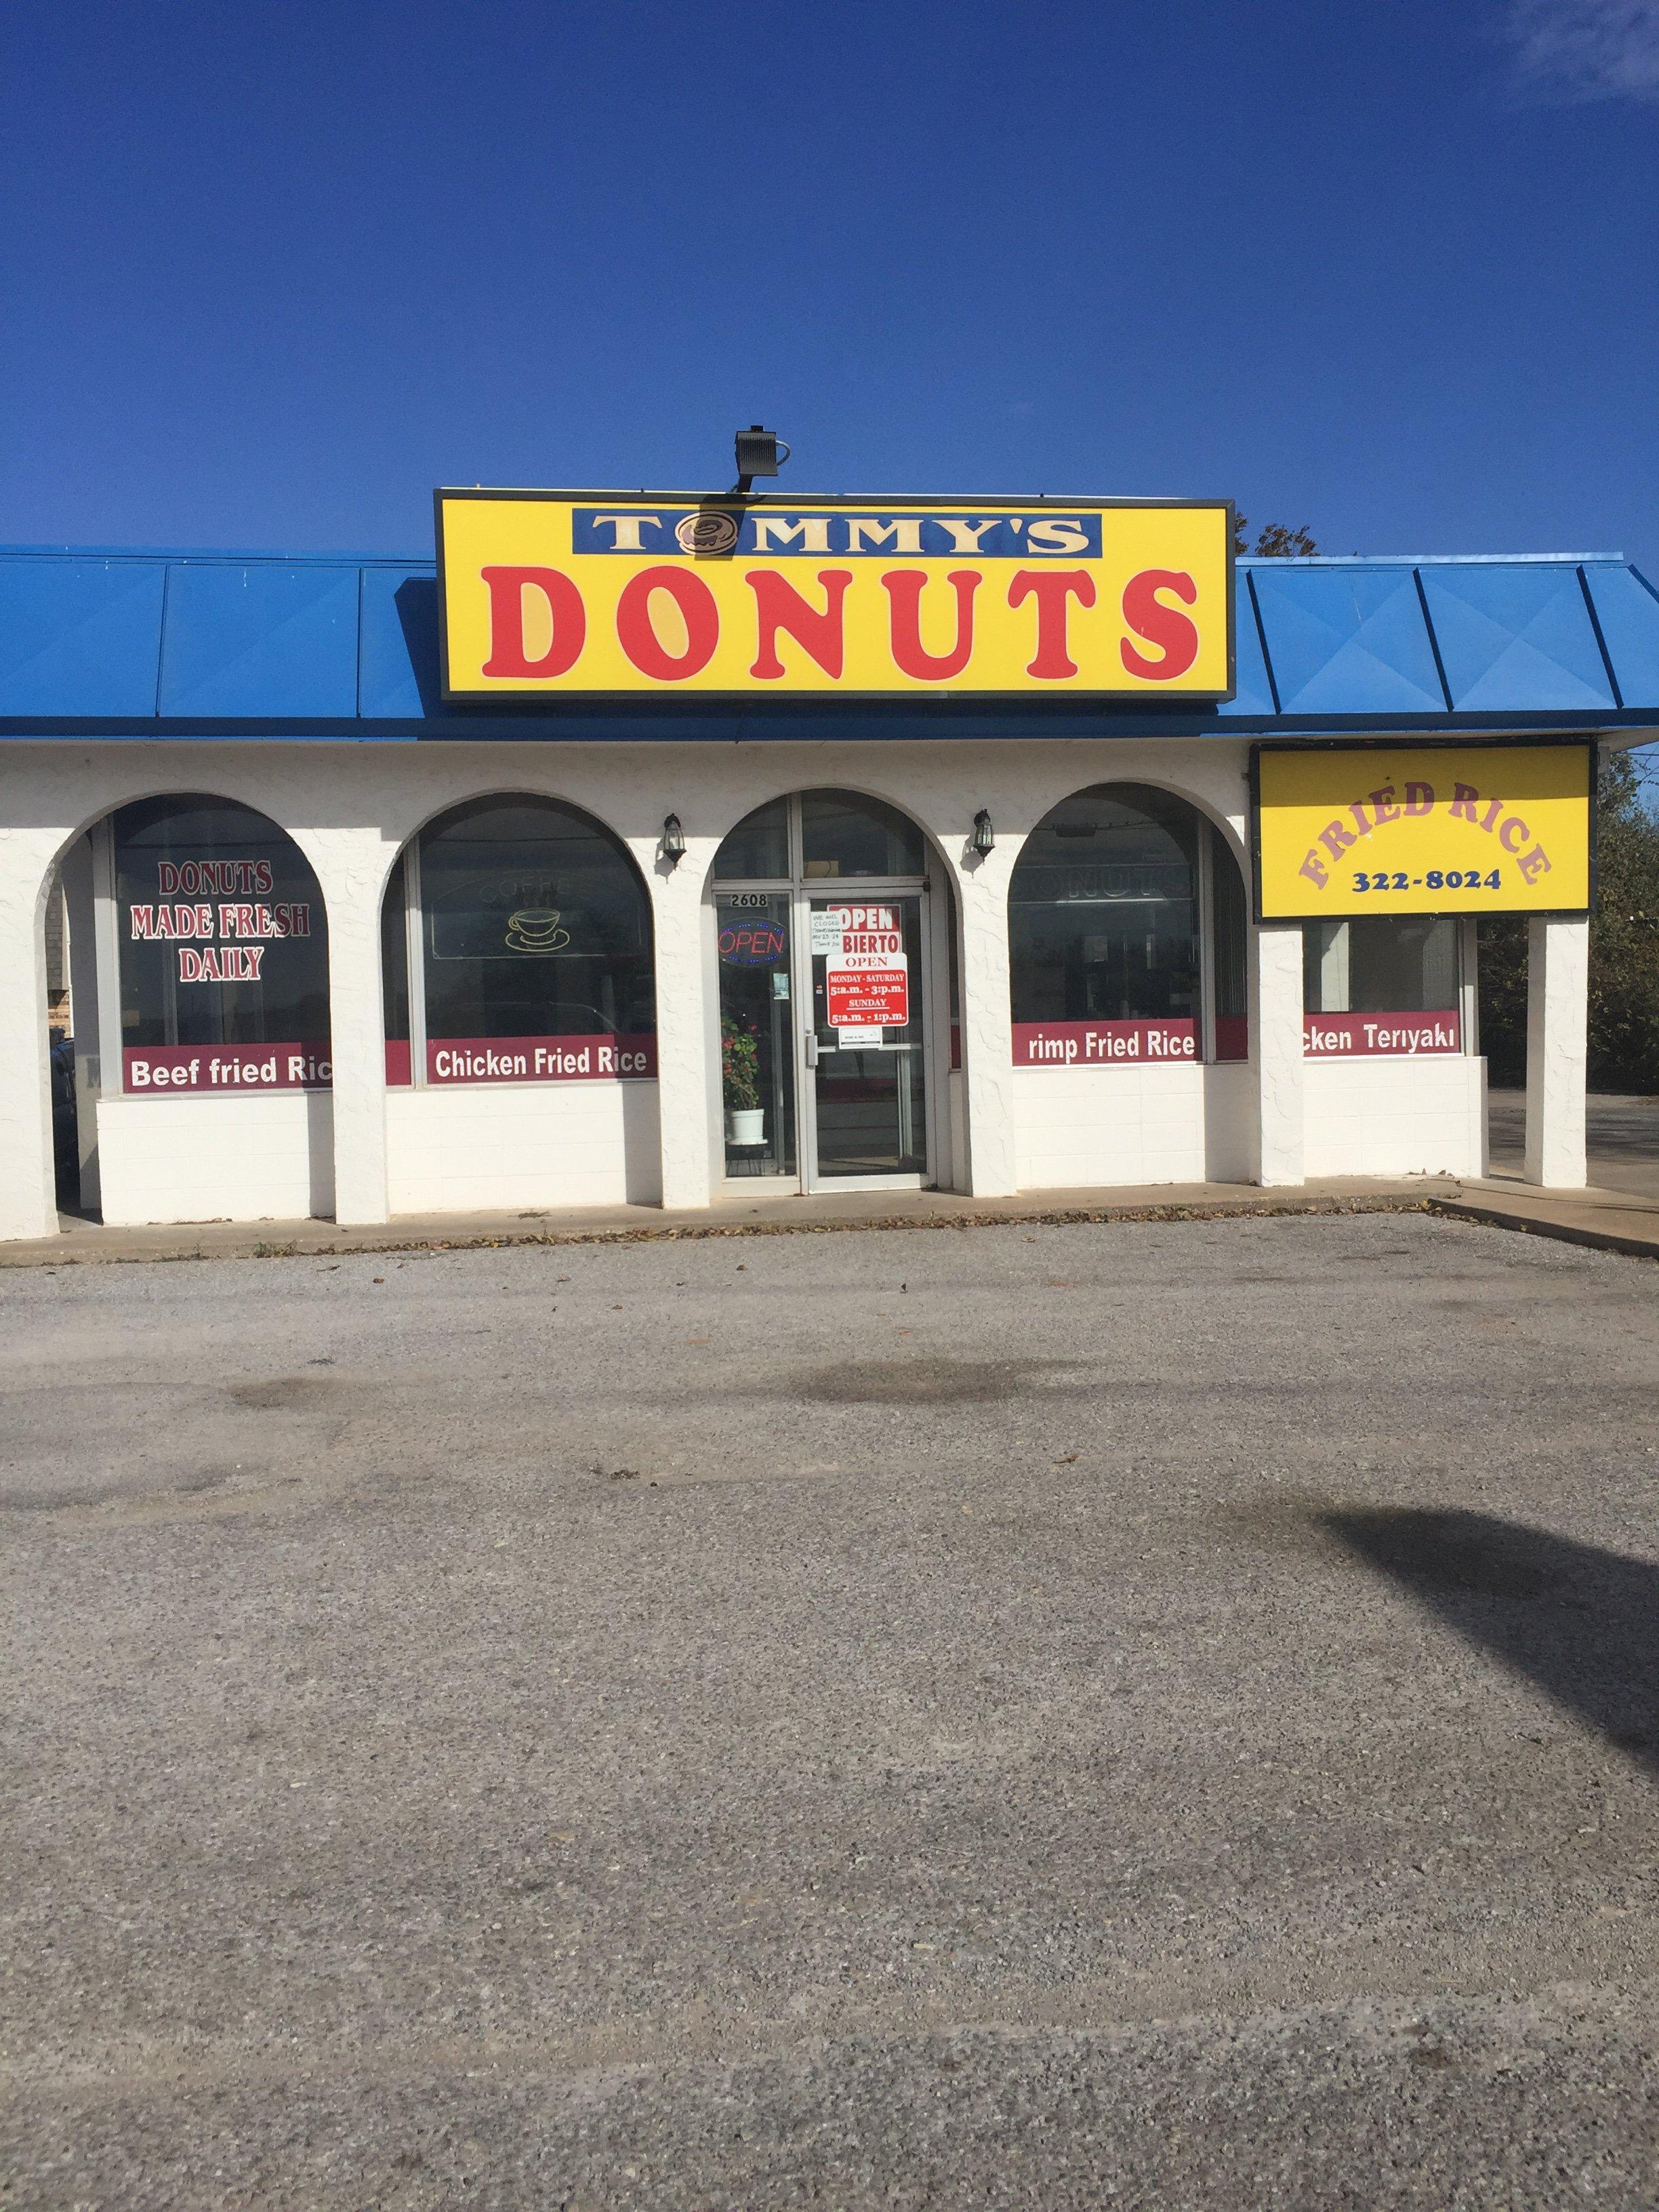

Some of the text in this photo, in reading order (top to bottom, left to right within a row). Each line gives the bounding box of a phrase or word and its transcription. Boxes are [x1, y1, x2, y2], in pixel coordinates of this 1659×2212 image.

[592, 510, 1091, 556] TOMMY'S
[480, 565, 1200, 681] DONUTS
[1298, 781, 1552, 890] FRIED RICE
[158, 860, 273, 895] DONUTS
[1351, 869, 1502, 892] 322-8024
[731, 894, 767, 906] 2608
[130, 903, 310, 939] MADE FRESH
[838, 907, 893, 930] OPEN
[718, 931, 785, 954] OPEN
[178, 946, 264, 982] DAILY
[845, 957, 888, 967] OPEN
[830, 975, 862, 983] MONDAY
[866, 974, 905, 982] SATURDAY
[831, 986, 863, 996] 5:a.m.
[871, 985, 905, 995] 3:p.m.
[848, 998, 887, 1007] SUNDAY
[832, 1014, 865, 1024] 5:a.m.
[1029, 1030, 1195, 1065] rimp Fried Rice
[131, 1059, 200, 1086] Beef
[209, 1057, 276, 1084] fried
[435, 1046, 647, 1077] Chicken Fried Rice
